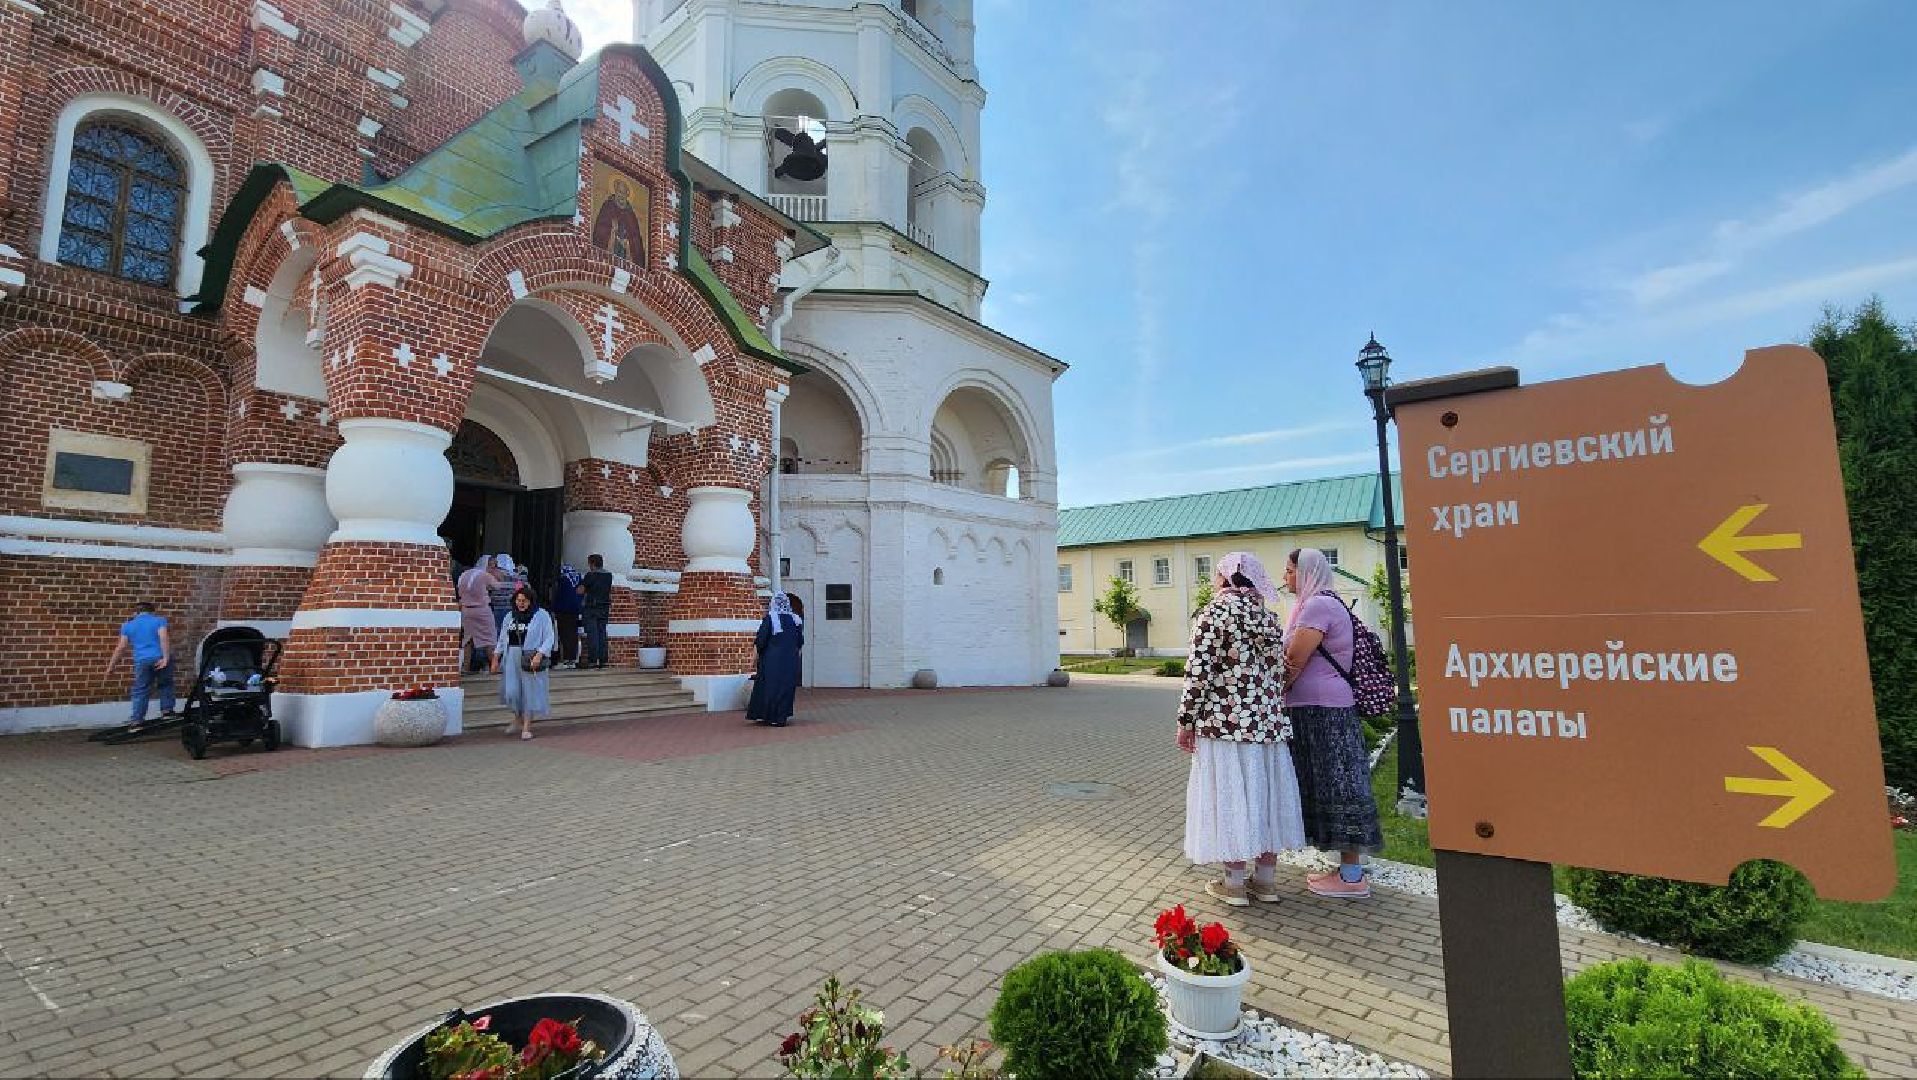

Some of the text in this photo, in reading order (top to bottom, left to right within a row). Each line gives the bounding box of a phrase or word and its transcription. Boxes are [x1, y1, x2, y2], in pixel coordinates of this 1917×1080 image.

[1427, 413, 1675, 484] Сергиевский
[1430, 500, 1519, 539] храм
[1444, 640, 1738, 689] Архиерейские
[1448, 706, 1587, 739] палаты
